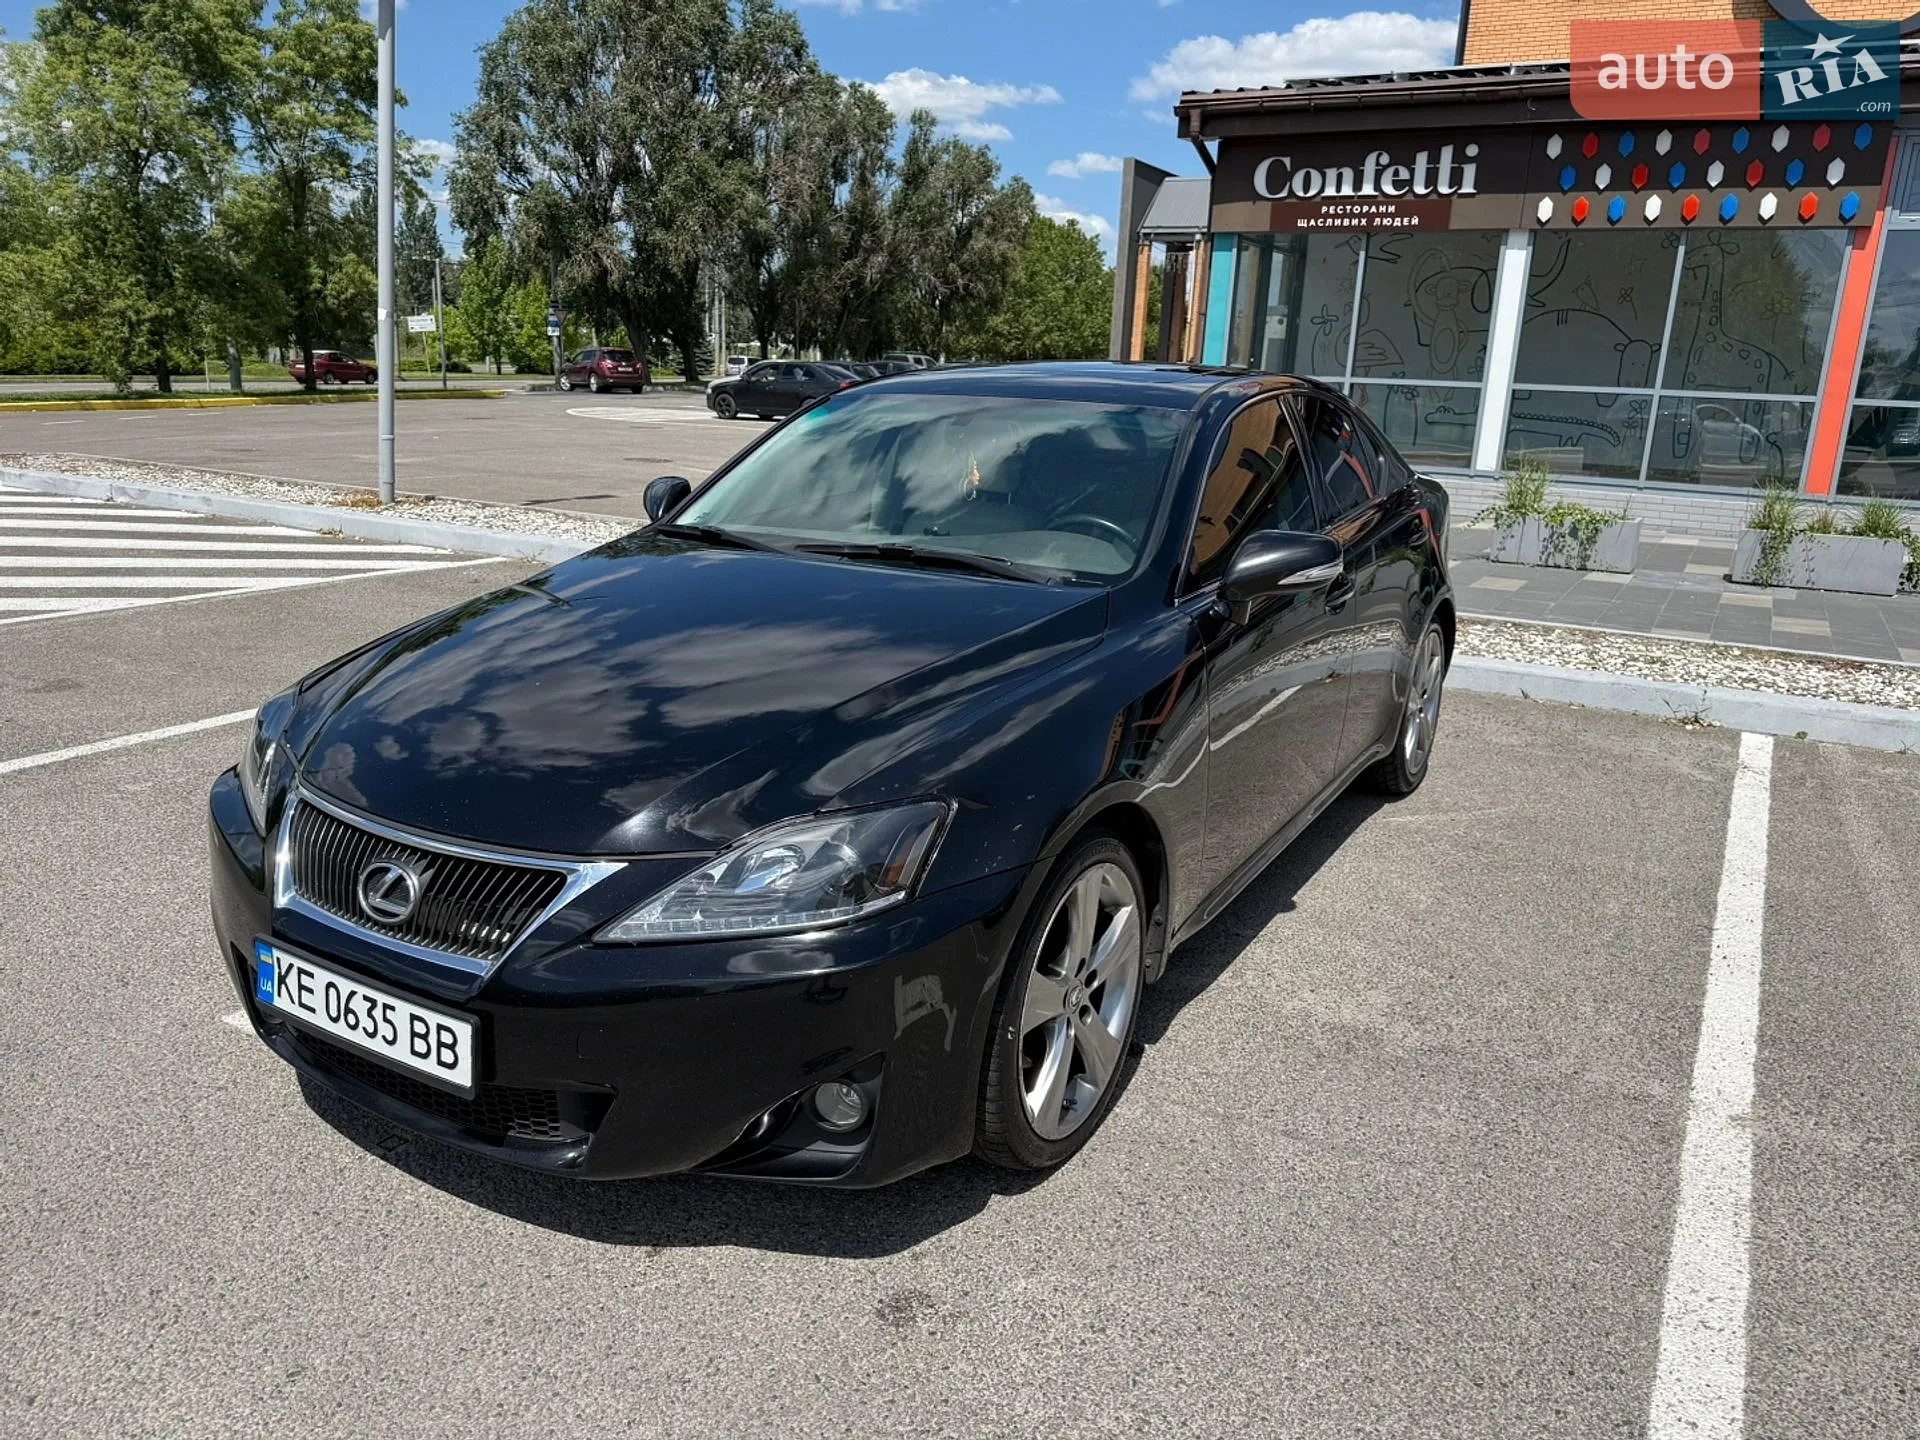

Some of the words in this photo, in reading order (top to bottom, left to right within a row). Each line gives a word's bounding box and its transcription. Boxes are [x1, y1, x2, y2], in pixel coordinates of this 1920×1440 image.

[1253, 143, 1479, 199] Confetti
[1321, 205, 1396, 215] РЕСТОРАНИ
[1297, 218, 1367, 228] ЩАСЛИВИХ
[1373, 215, 1419, 227] ЛЮДЕЙ
[260, 979, 273, 994] UA
[275, 956, 317, 1015] KE
[325, 981, 398, 1047] 0635
[409, 1012, 459, 1071] BB
